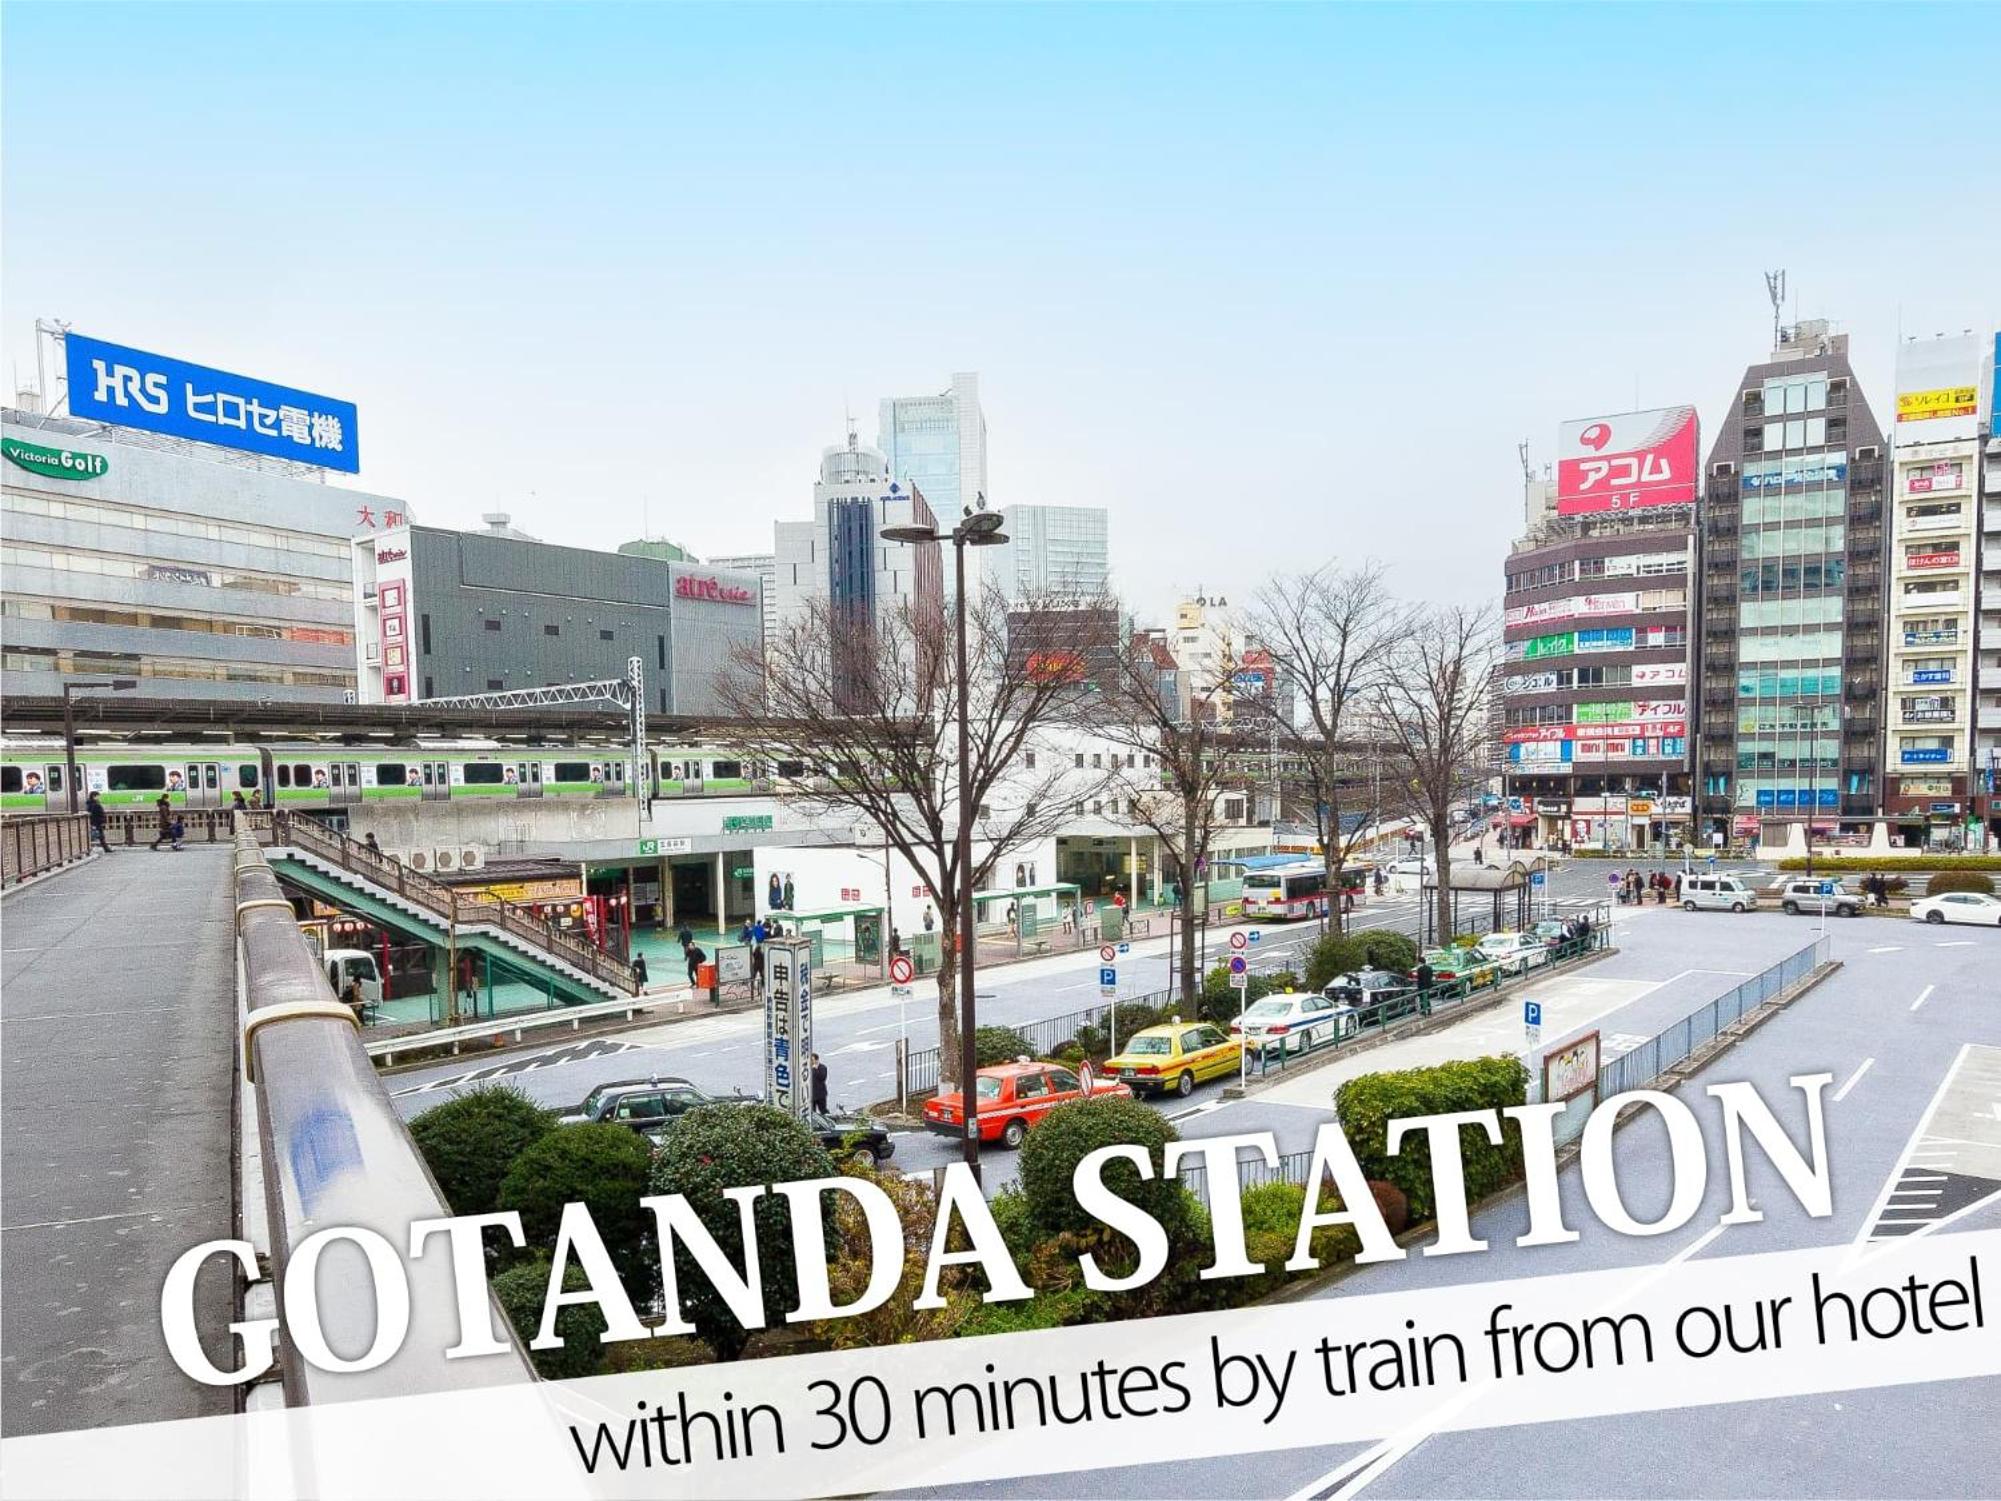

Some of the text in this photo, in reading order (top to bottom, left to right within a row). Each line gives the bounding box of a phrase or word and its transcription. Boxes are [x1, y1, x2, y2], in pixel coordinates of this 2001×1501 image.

[92, 359, 343, 453] HRS ヒロセ電機
[9, 447, 103, 474] Victoria Golf
[1579, 453, 1671, 490] アコム
[642, 841, 656, 851] JR
[773, 962, 791, 1110] 申告は青色で
